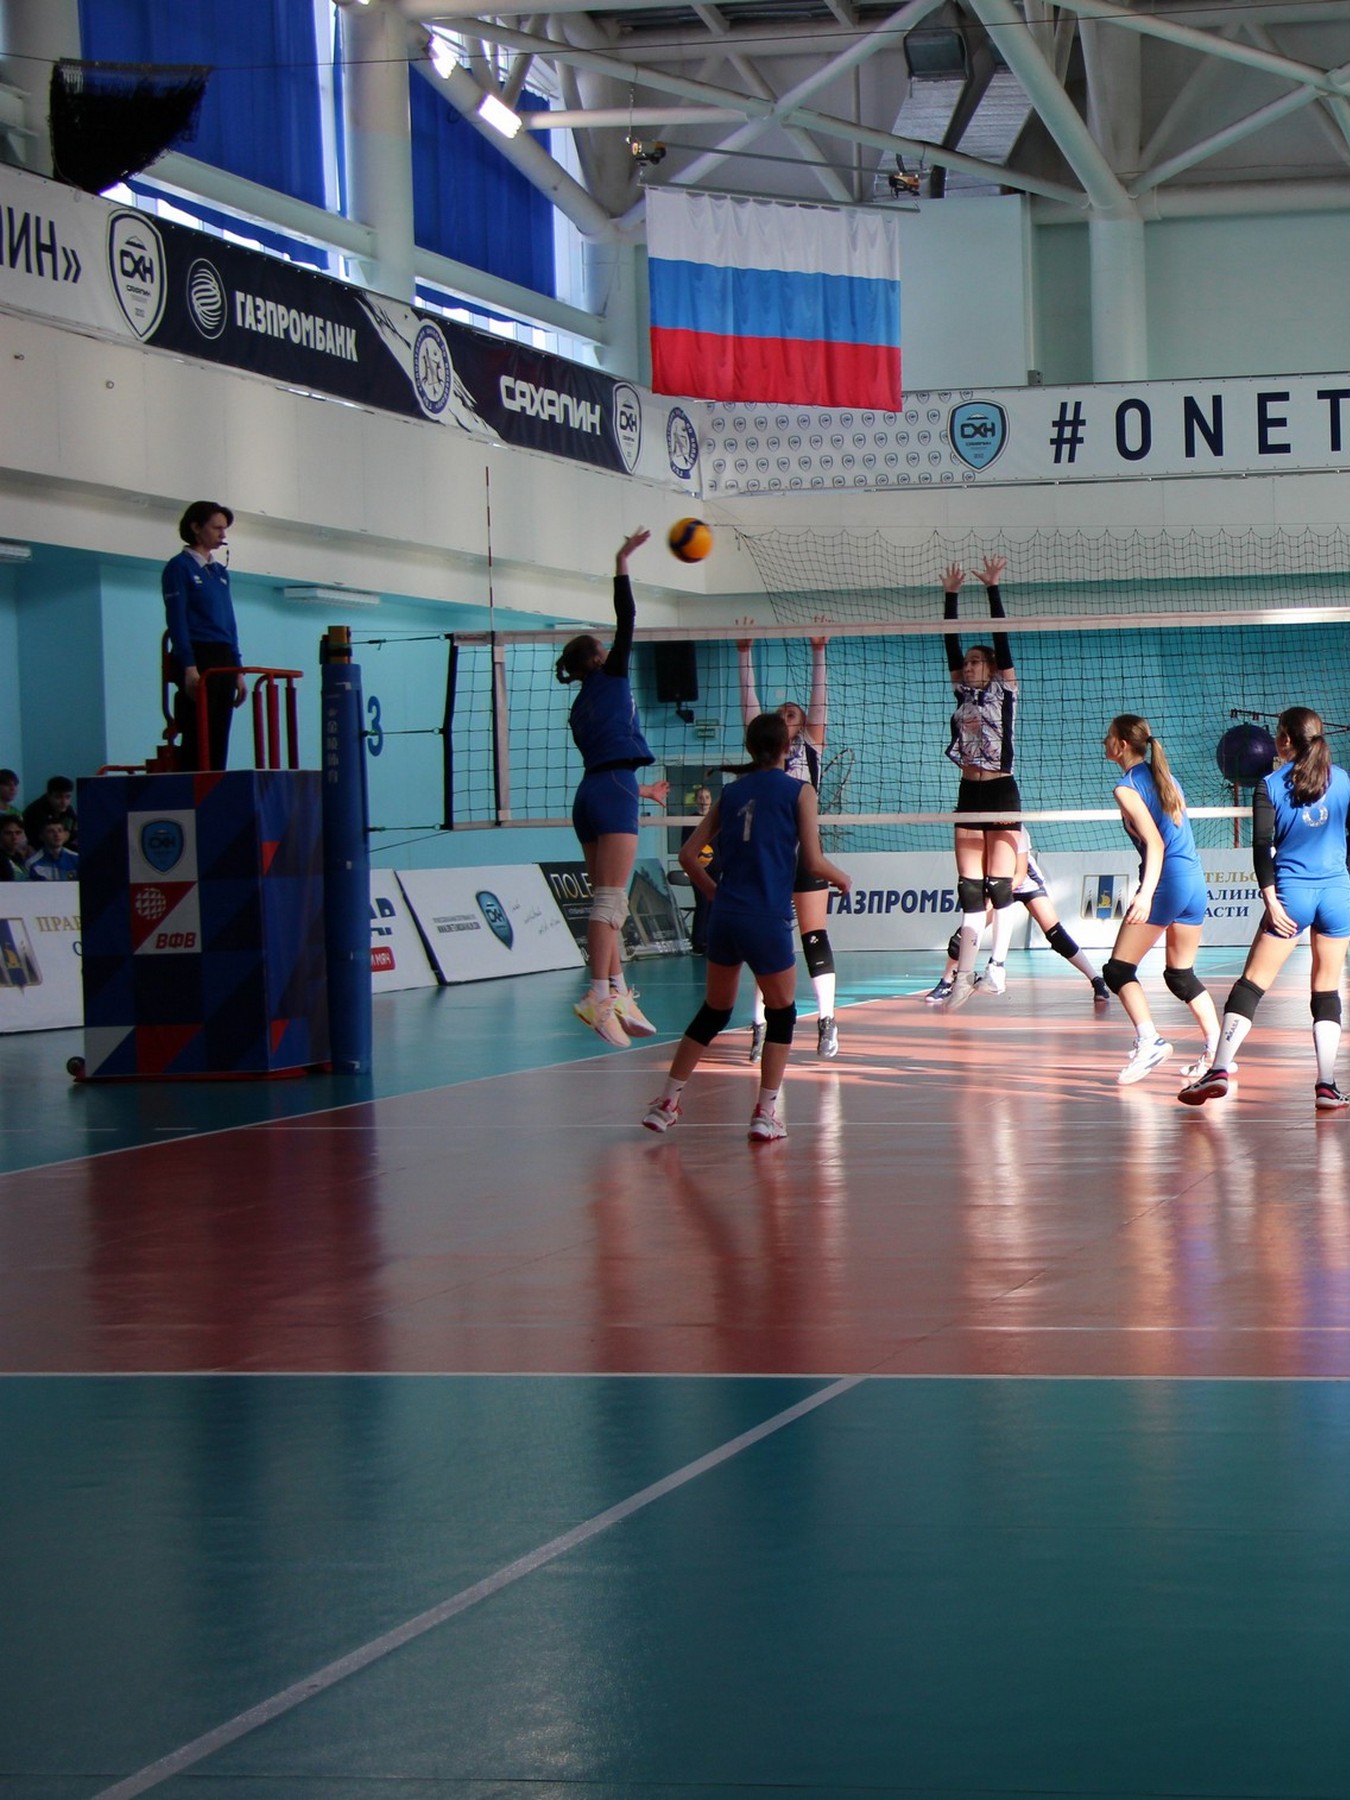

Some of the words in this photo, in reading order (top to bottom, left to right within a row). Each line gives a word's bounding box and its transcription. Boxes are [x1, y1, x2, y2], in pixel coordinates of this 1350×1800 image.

[0, 204, 81, 284] ИН»
[235, 290, 359, 362] ГАЗПРОМБАНК
[501, 375, 601, 435] САХАЛИН
[367, 696, 383, 757] 3
[737, 799, 756, 842] 1
[156, 932, 196, 949] ВФВ
